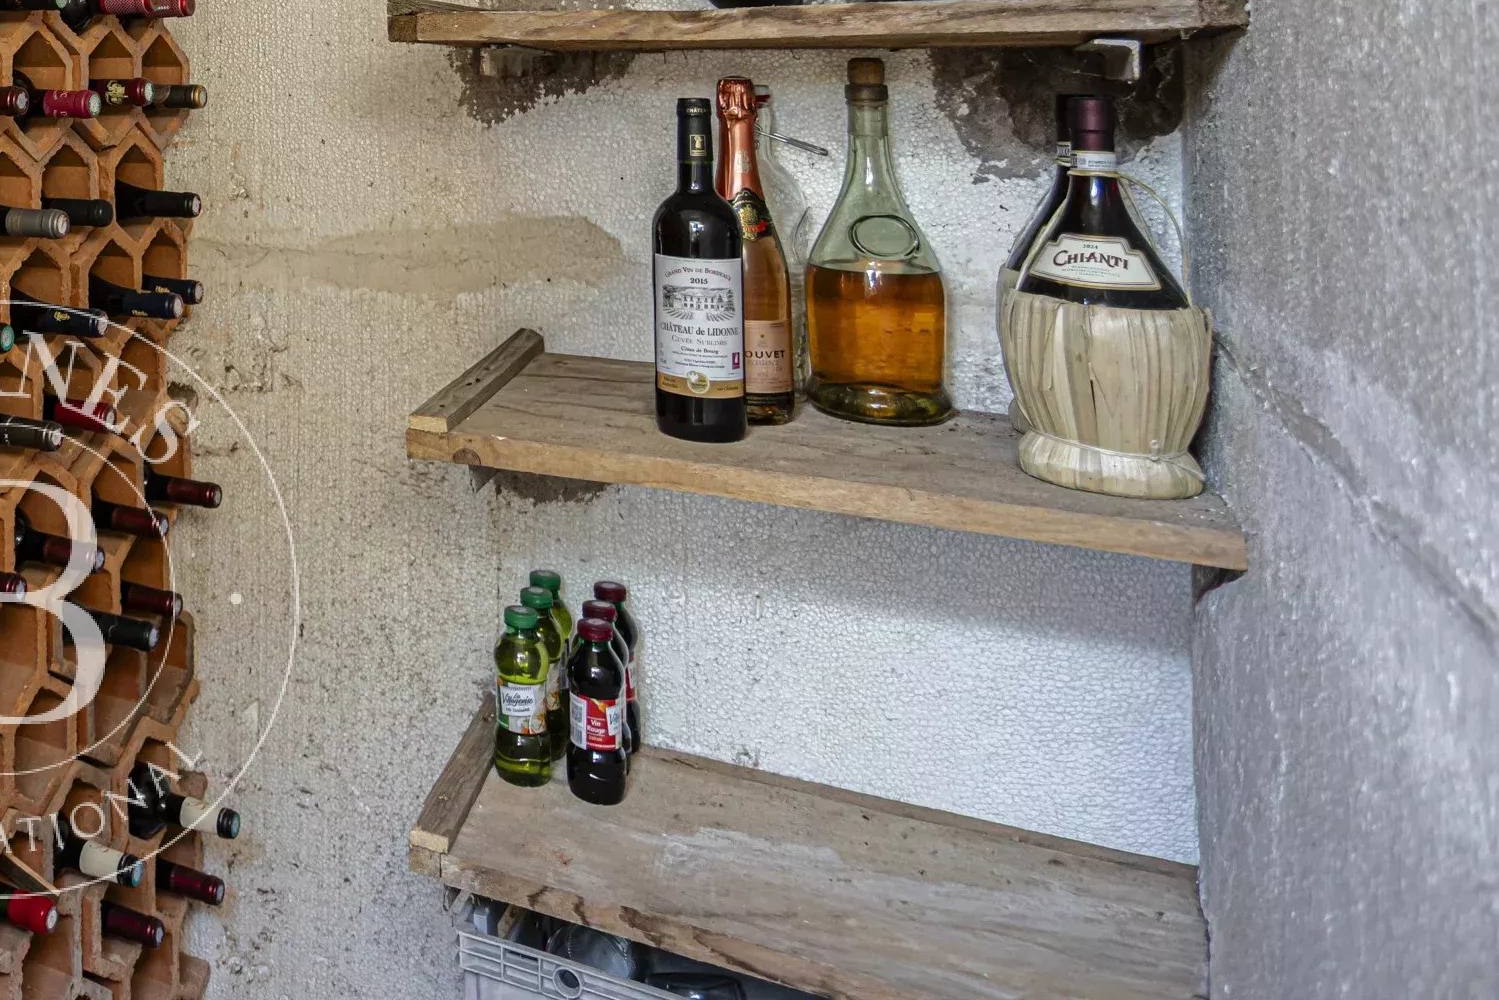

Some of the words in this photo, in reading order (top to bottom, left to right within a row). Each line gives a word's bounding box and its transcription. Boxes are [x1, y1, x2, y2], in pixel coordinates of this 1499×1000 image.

[1052, 250, 1129, 271] CHIANTI
[689, 277, 709, 285] 2015
[660, 321, 694, 335] CHÂTEAU
[695, 326, 706, 336] de
[707, 327, 739, 337] LIDONNE
[745, 350, 786, 359] OUVET
[591, 719, 601, 727] Vin
[587, 724, 606, 736] Rouge
